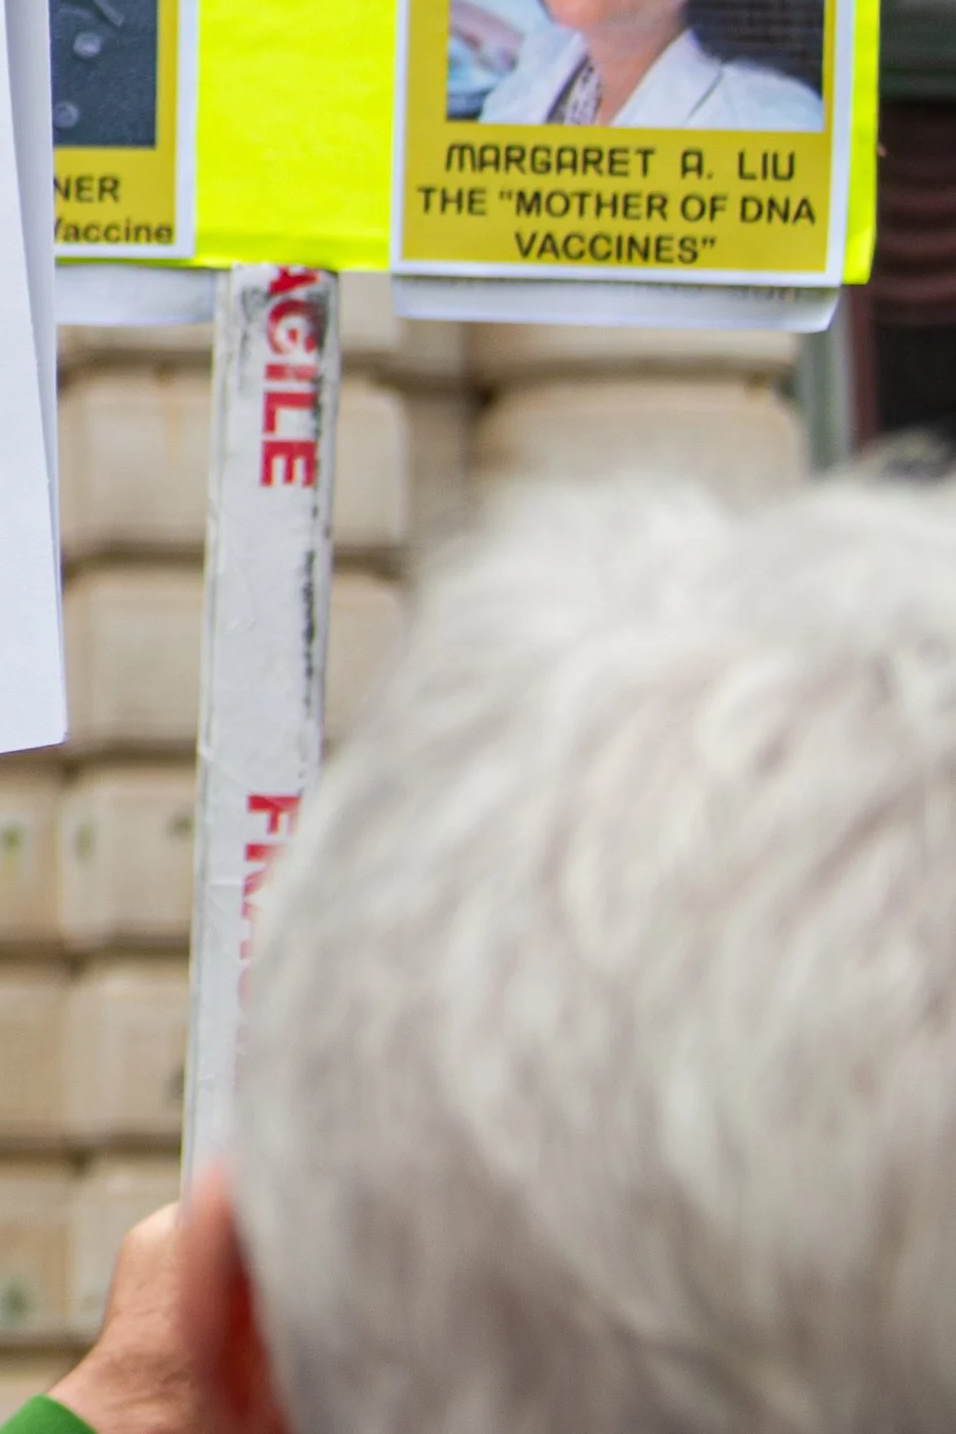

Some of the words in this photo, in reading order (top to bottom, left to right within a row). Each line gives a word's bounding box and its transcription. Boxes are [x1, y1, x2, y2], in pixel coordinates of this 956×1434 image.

[444, 142, 656, 178] MARGARET
[680, 148, 714, 181] A.
[737, 150, 796, 182] LIU
[417, 185, 487, 216] THE
[499, 189, 669, 221] “MOTHER
[679, 193, 729, 223] OF
[739, 195, 816, 225] DNA
[514, 231, 717, 265] VACCINES”
